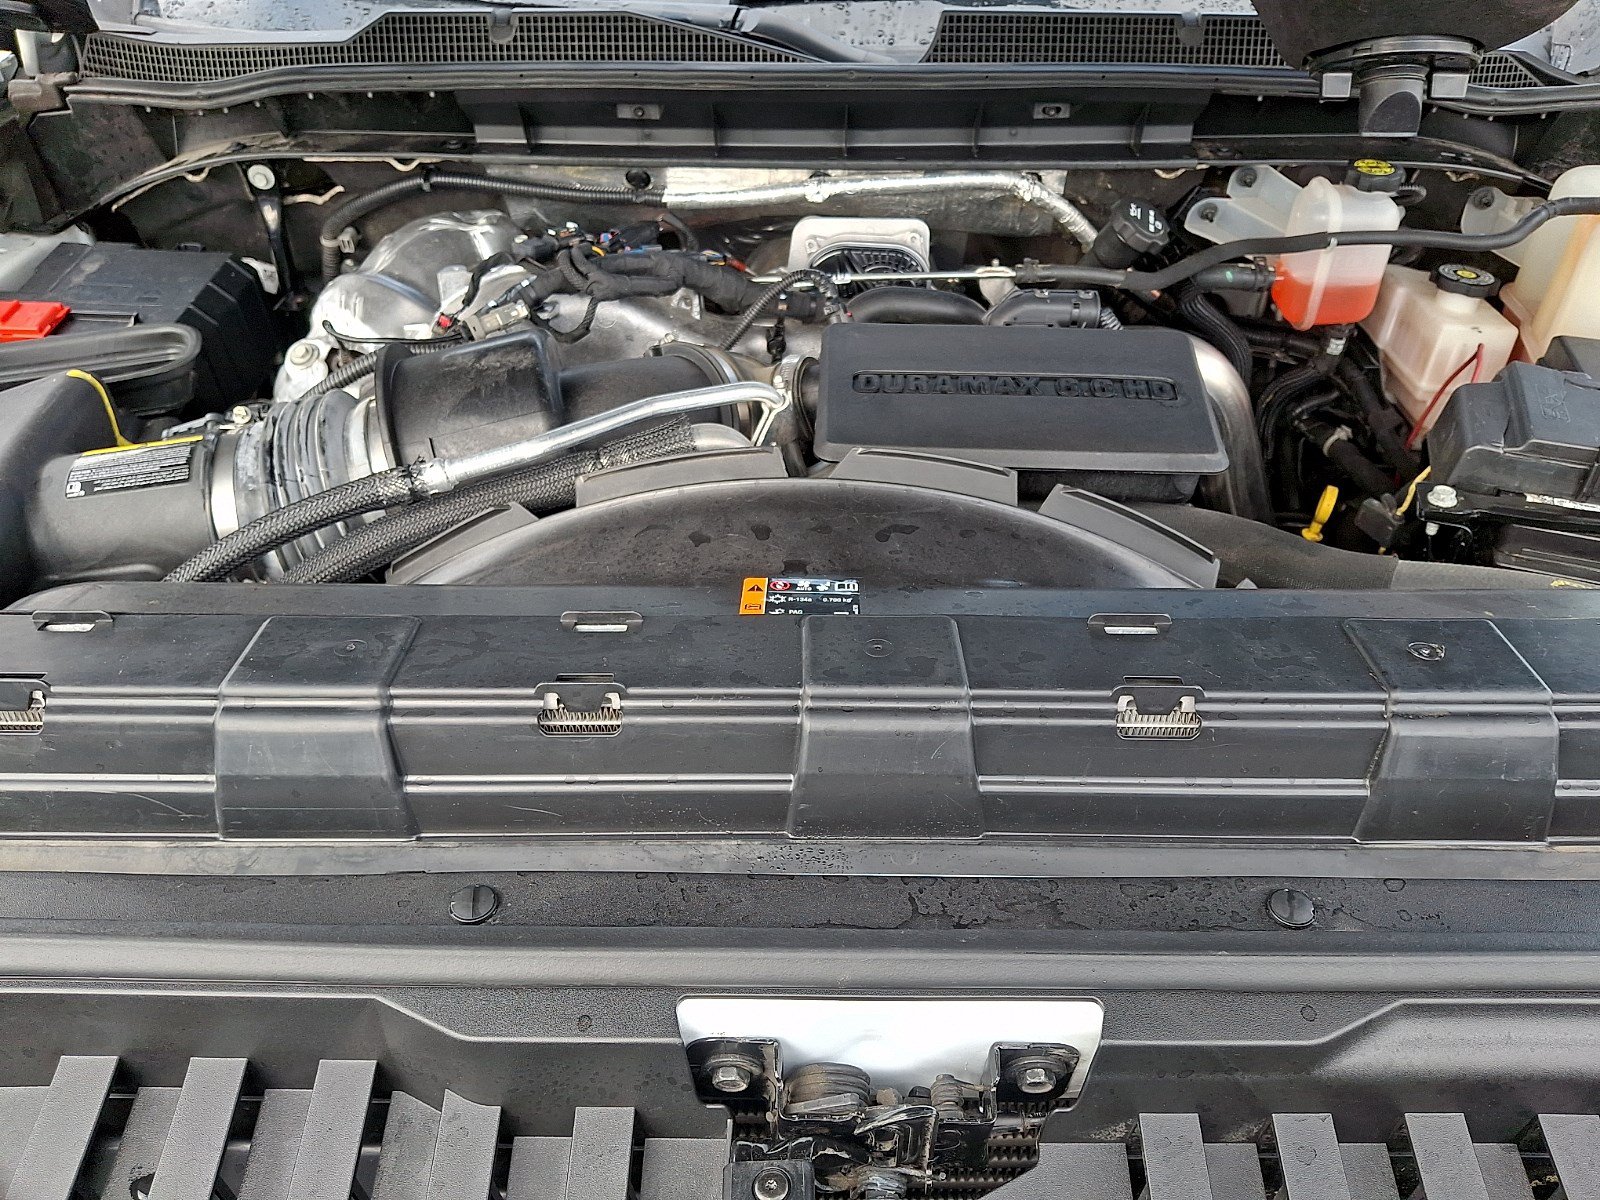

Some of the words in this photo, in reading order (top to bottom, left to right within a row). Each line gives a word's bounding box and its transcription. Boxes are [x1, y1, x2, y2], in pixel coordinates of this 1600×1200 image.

[855, 373, 1043, 396] DURAMAX
[1055, 377, 1118, 398] 6.6
[1122, 379, 1175, 400] HD
